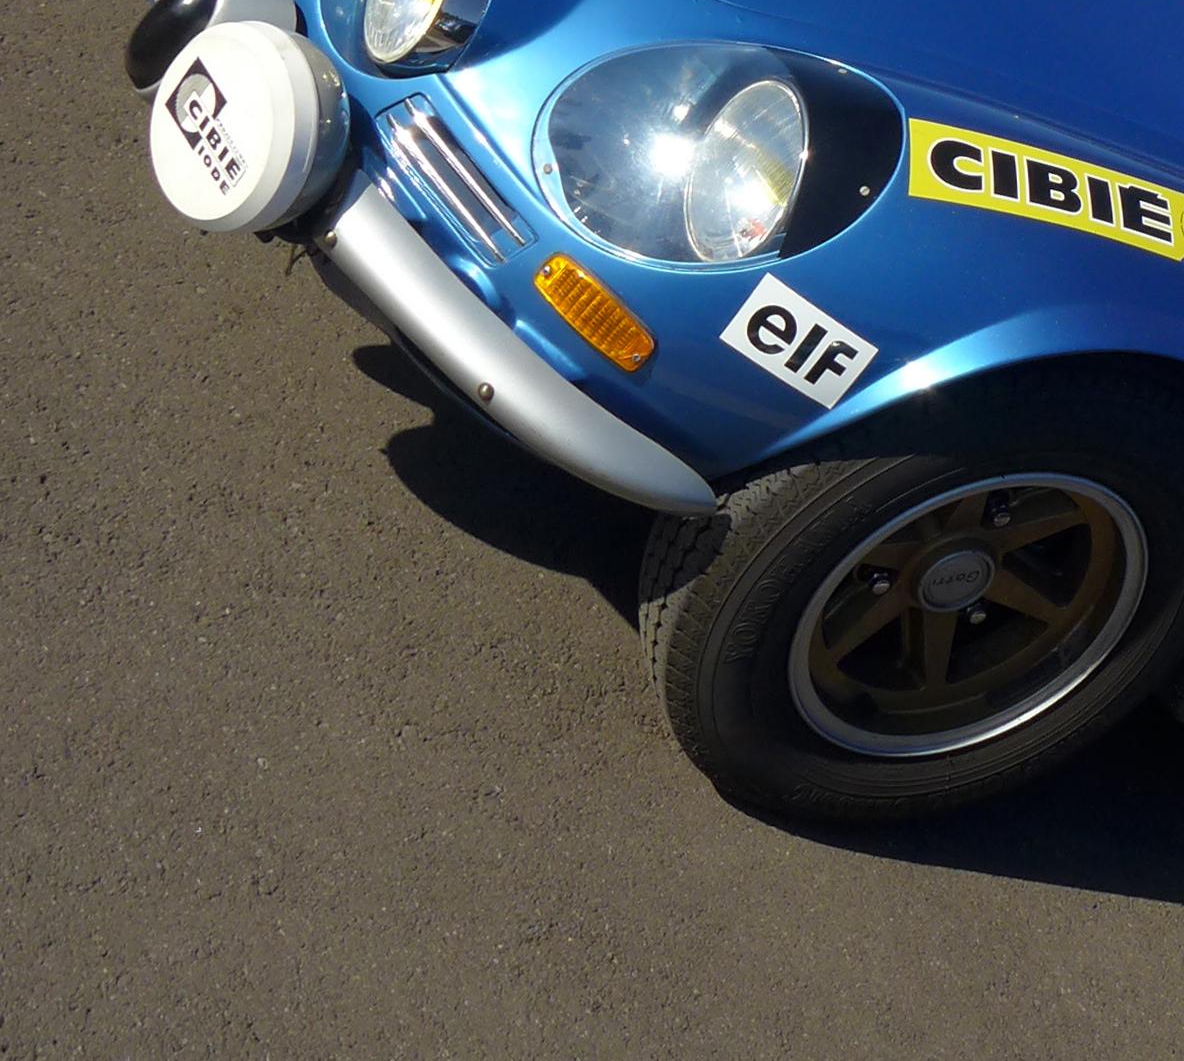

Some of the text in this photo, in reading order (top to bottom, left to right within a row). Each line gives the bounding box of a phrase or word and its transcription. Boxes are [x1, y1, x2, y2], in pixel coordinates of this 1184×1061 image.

[189, 99, 241, 181] CIBIE
[198, 146, 230, 195] IODE
[745, 303, 858, 387] elf
